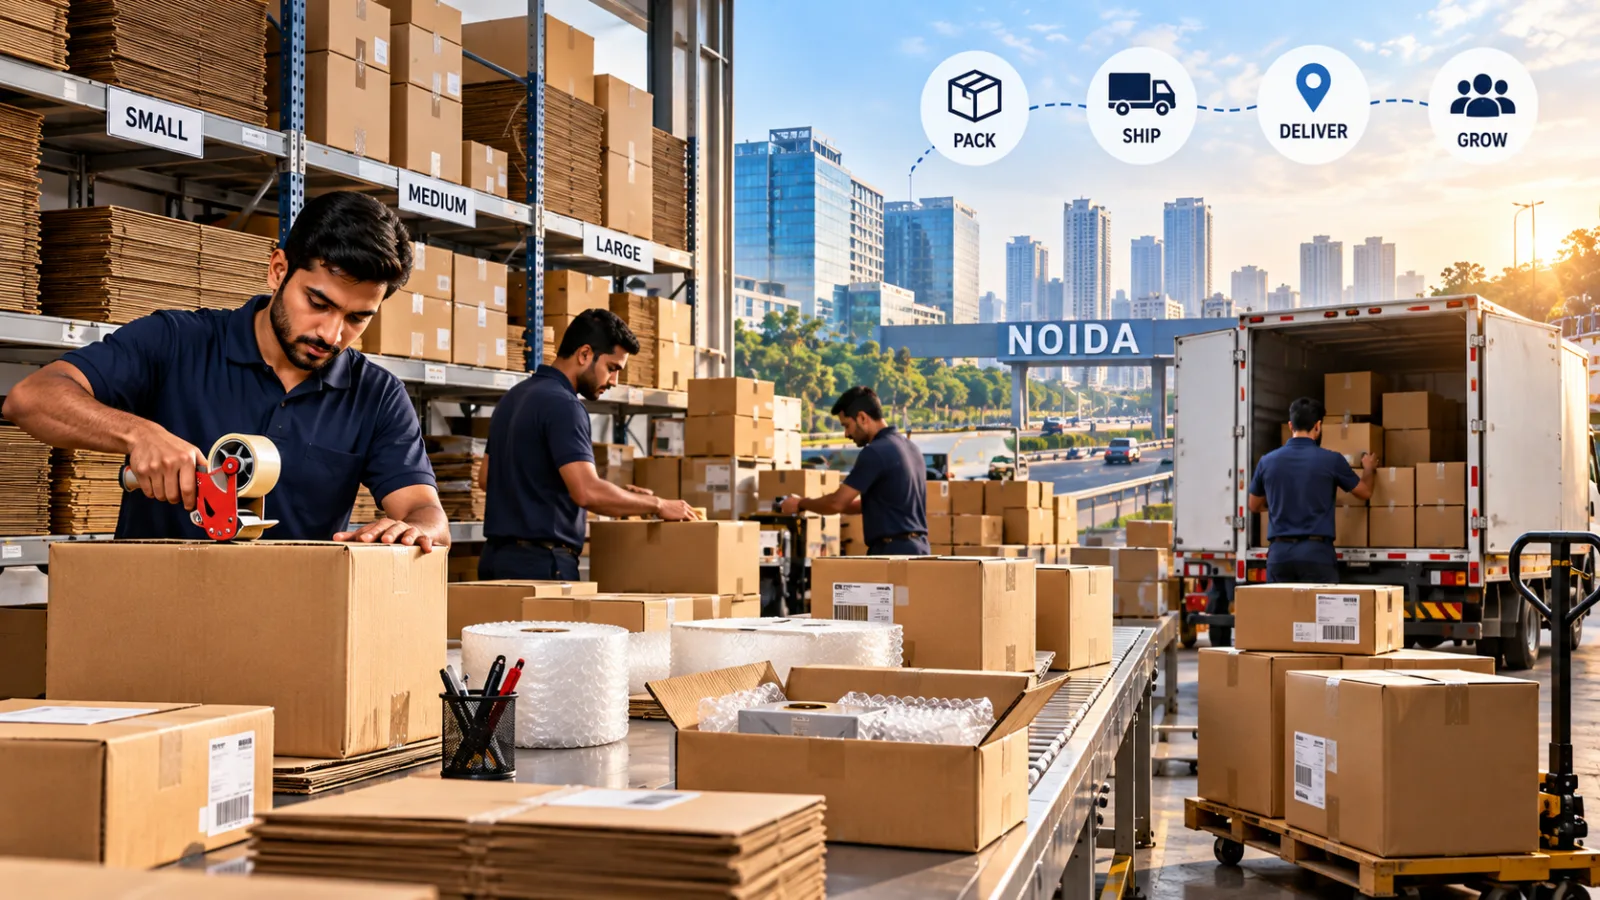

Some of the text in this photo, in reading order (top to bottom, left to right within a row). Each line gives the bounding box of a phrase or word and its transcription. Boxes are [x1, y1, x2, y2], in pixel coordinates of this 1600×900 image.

[126, 106, 189, 141] SMALL
[408, 184, 467, 215] MEDIUM
[596, 236, 641, 263] LARGE
[1008, 323, 1139, 355] NOIDA
